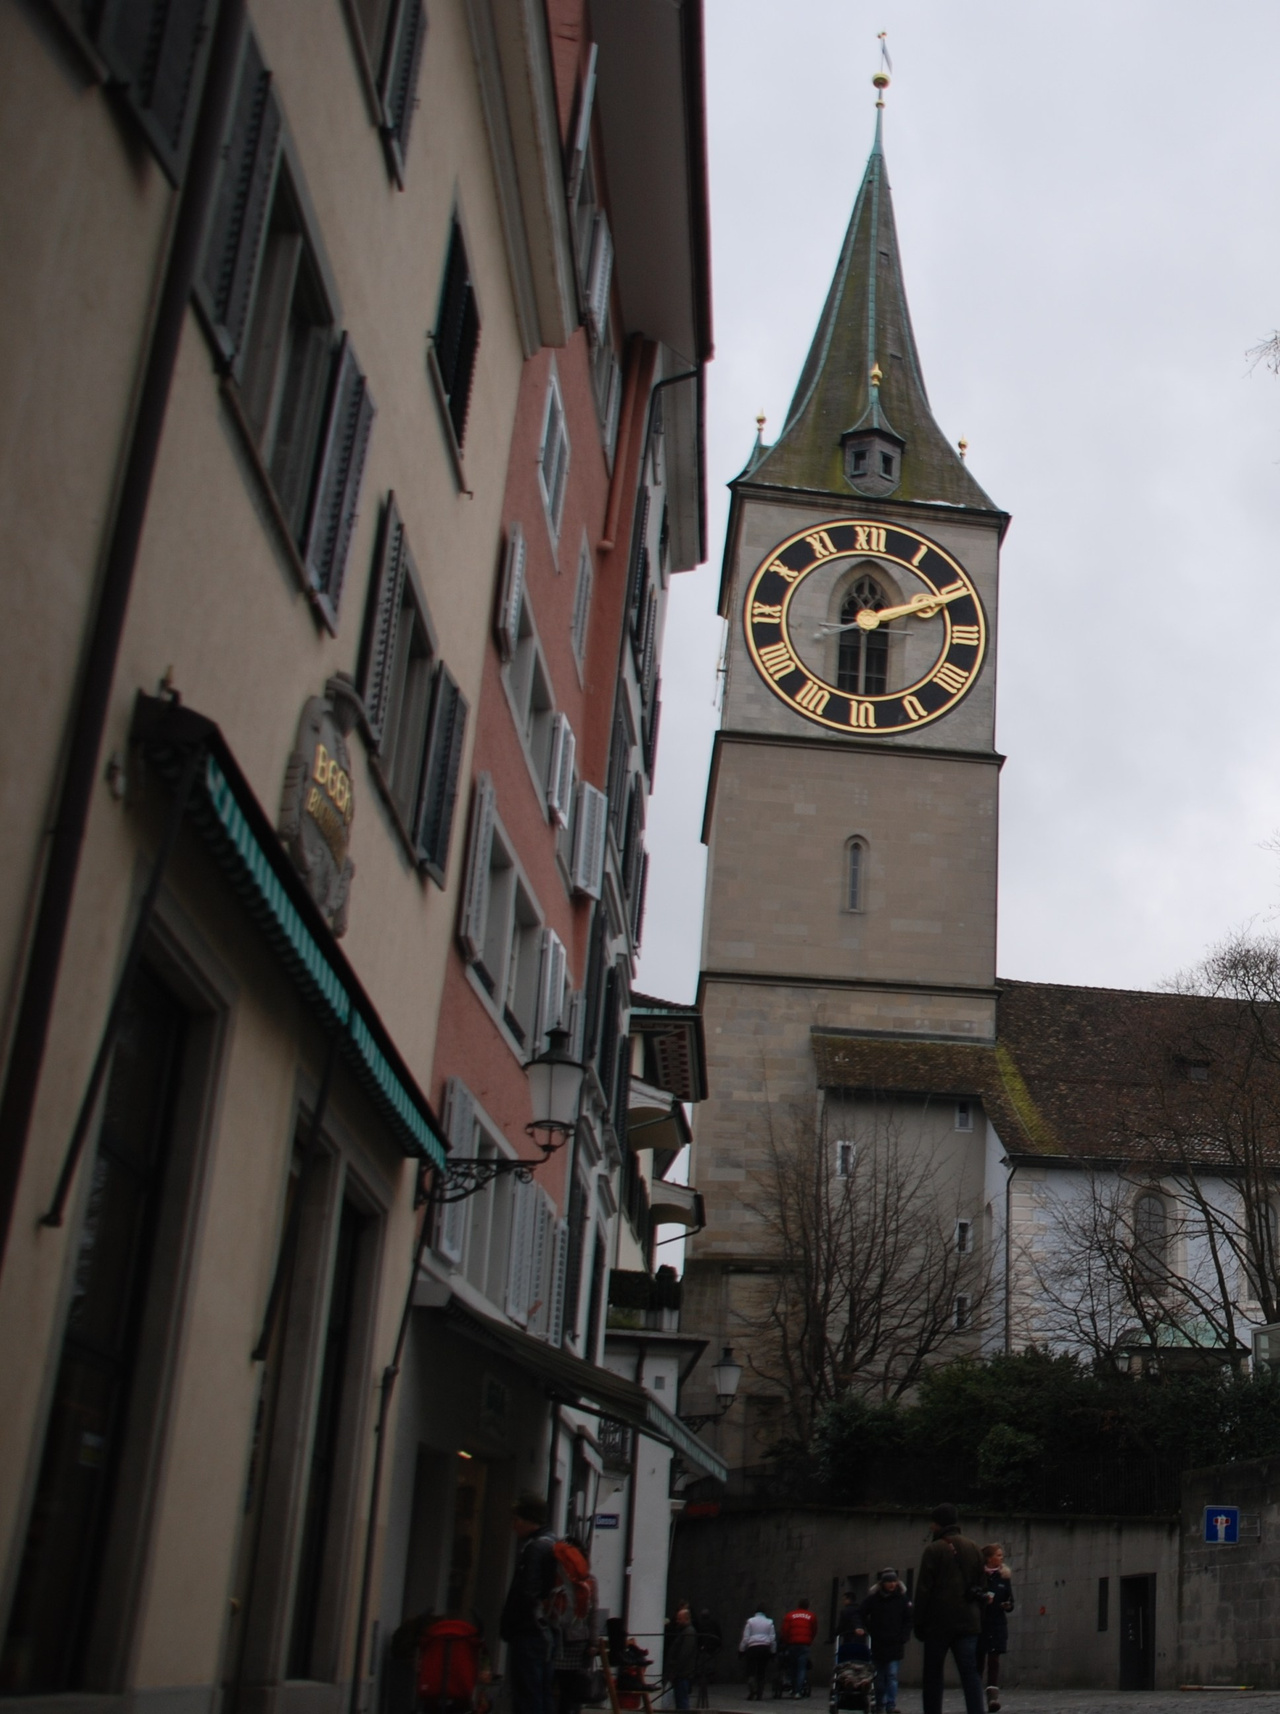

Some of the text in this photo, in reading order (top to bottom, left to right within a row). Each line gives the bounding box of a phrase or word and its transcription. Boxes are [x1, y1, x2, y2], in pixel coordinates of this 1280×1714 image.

[804, 531, 838, 559] XI
[854, 526, 887, 553] XII
[910, 544, 928, 567] I
[768, 559, 799, 582] X
[752, 601, 782, 624] IX
[951, 625, 979, 646] III
